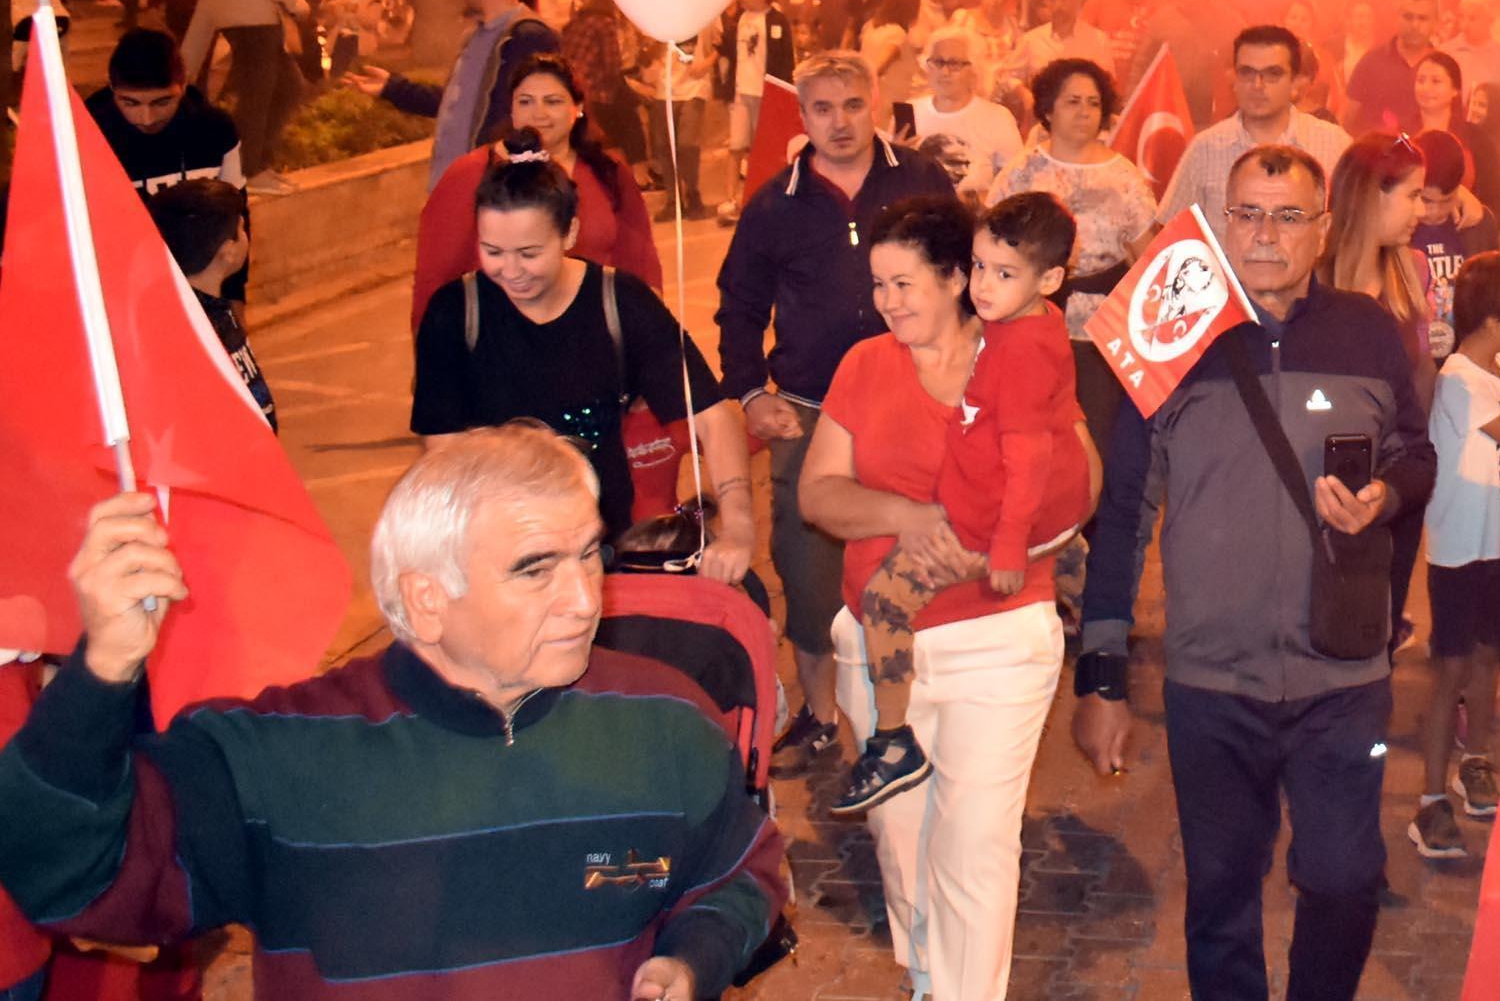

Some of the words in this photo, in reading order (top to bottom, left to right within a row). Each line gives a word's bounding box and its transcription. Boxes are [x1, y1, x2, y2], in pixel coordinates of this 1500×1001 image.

[1426, 243, 1445, 255] THE
[1106, 337, 1145, 389] ATA
[585, 852, 612, 866] navy
